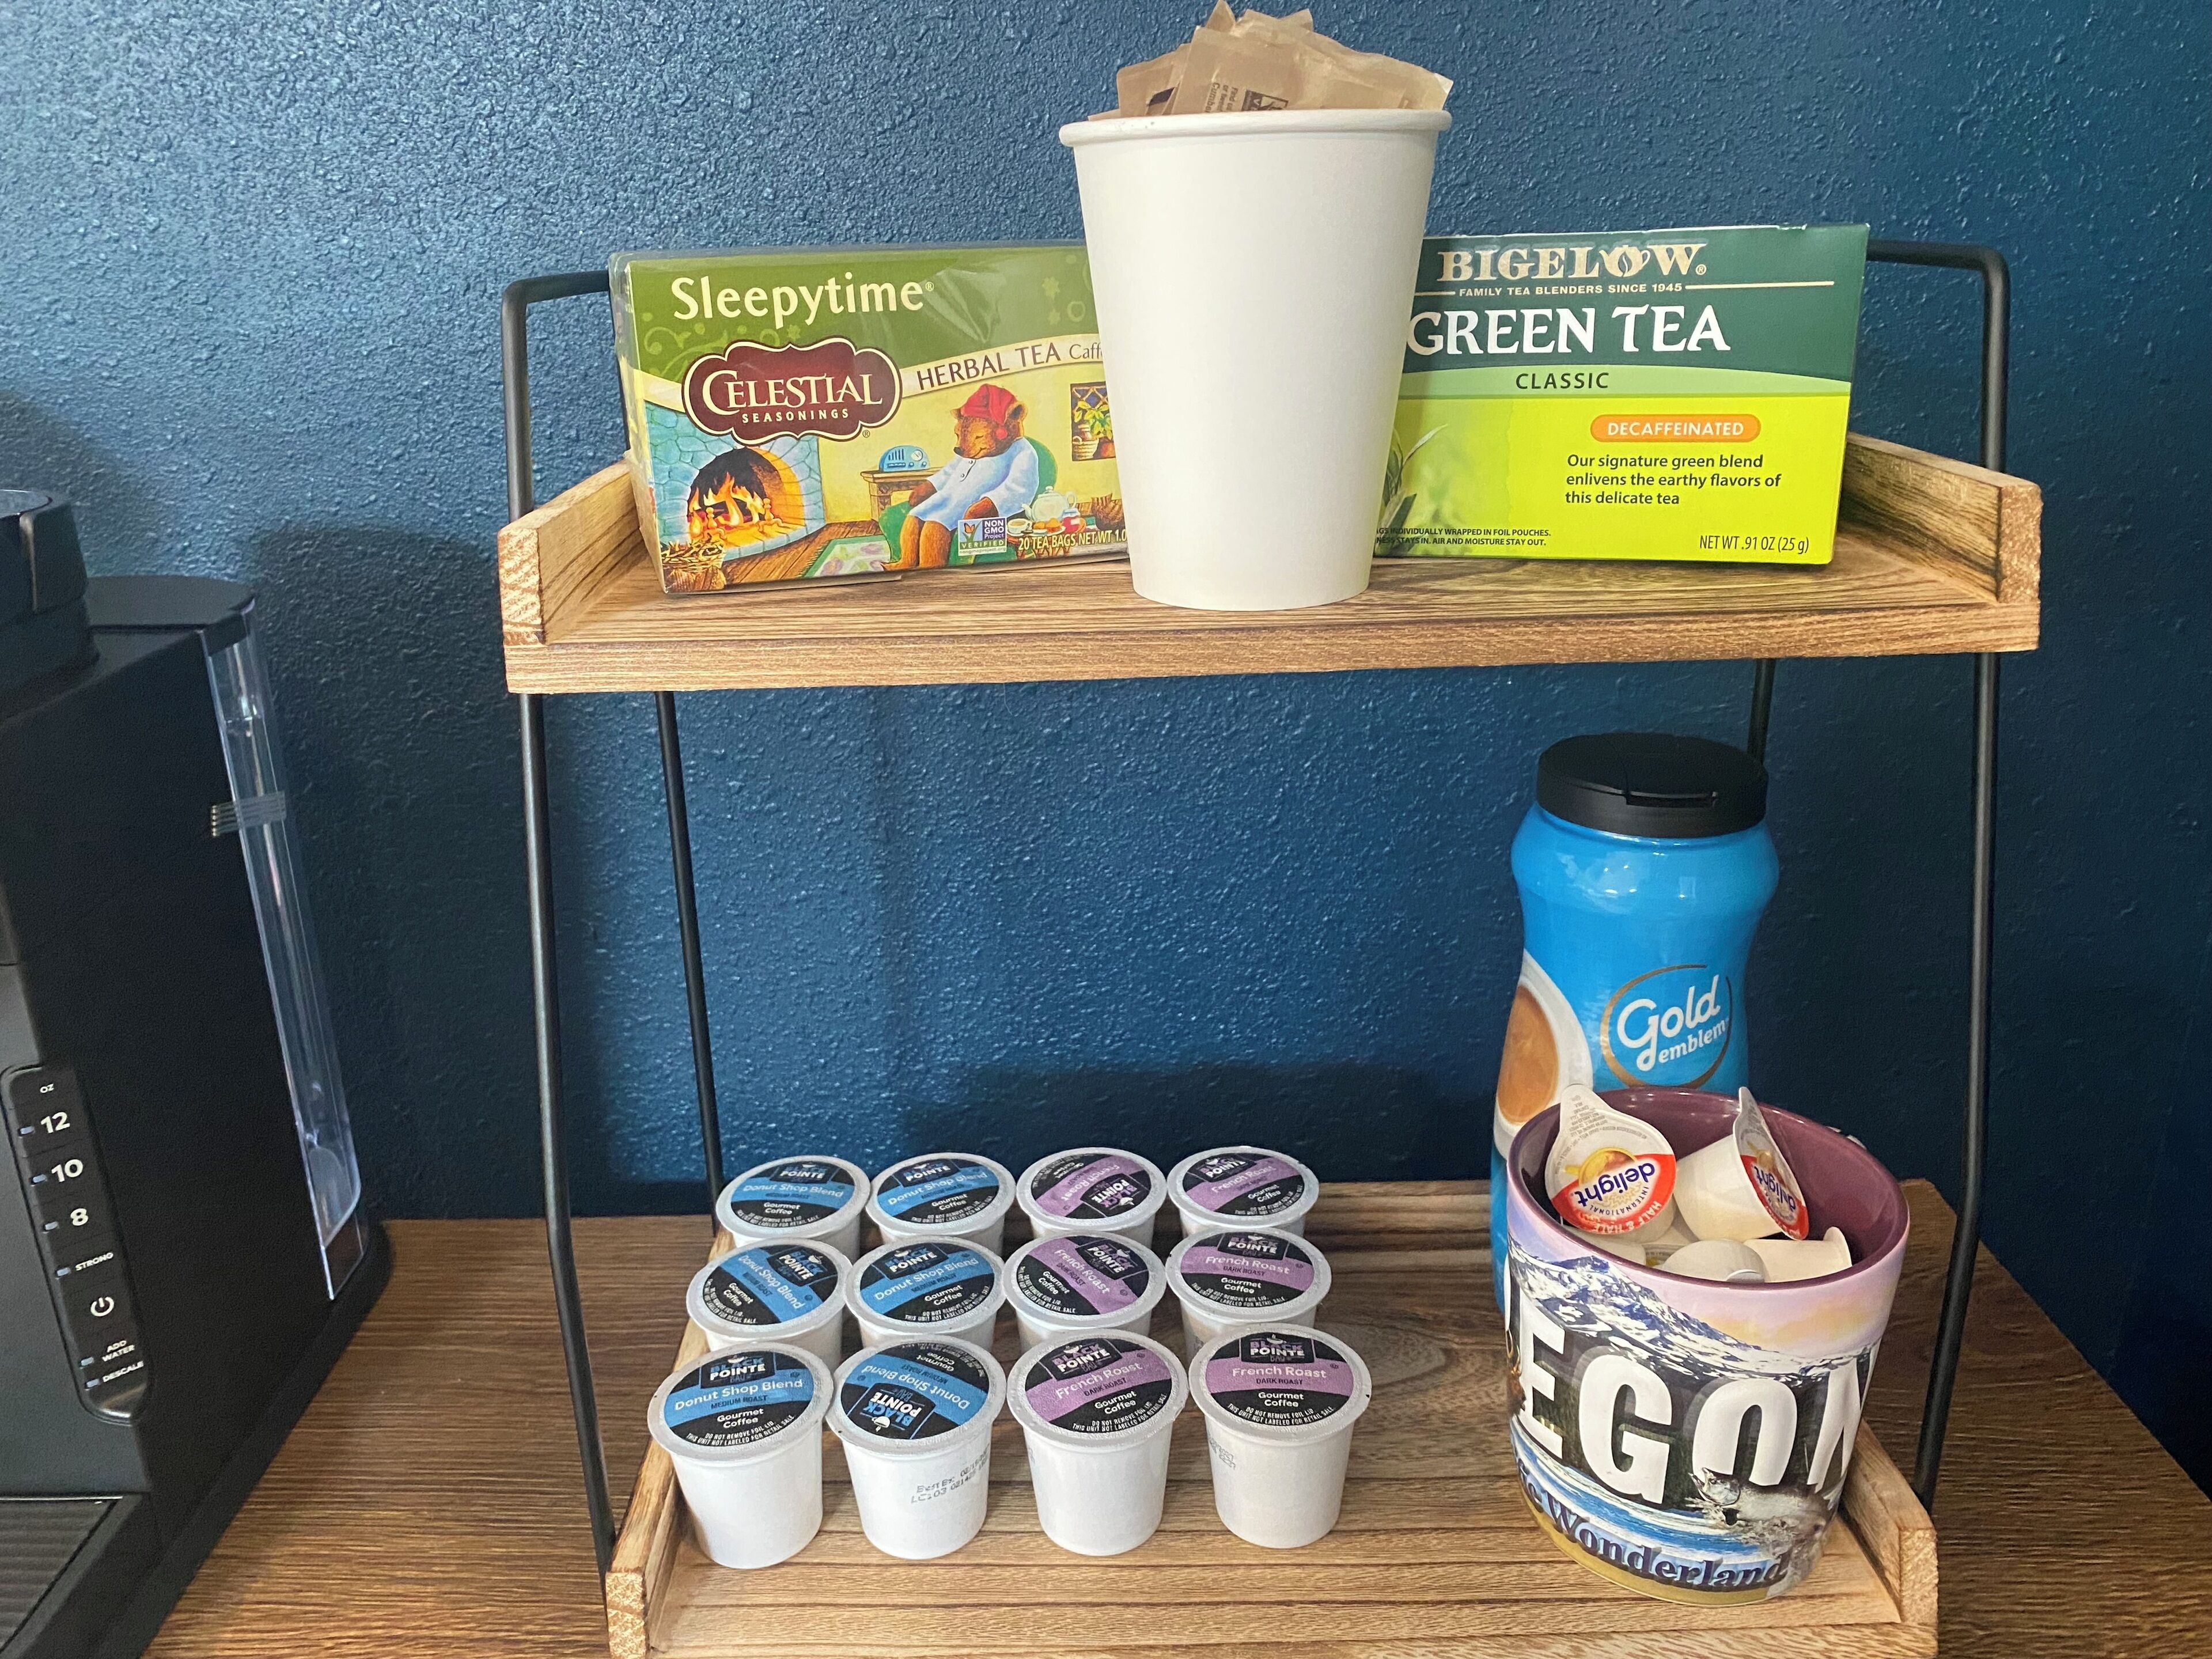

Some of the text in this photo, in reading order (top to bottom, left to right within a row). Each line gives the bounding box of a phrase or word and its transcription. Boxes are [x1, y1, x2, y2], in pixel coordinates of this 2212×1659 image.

[1459, 283, 1682, 297] FAMILY TEA BLENDERS SINCE 1945
[1407, 304, 1731, 355] GREEN TEA
[917, 352, 1009, 390] HERBAL
[1015, 342, 1061, 367] TEA
[1516, 373, 1609, 389] CLASSIC
[702, 370, 882, 415] CELESTIAL
[742, 408, 849, 423] SEASONINGS
[1608, 422, 1744, 436] DECAFFEINATED
[1567, 454, 1763, 470] Our signature green blend
[1566, 473, 1782, 489] enlivens the earthy flavors of
[1566, 491, 1680, 505] this delicate tea
[961, 540, 1004, 548] VERIFIED
[1018, 538, 1030, 550] 20
[1031, 537, 1050, 548] TEA
[1052, 534, 1076, 548] BAGS
[1078, 532, 1095, 544] NET
[1096, 530, 1112, 543] WT
[1699, 535, 1809, 554] NET WT .91 OZ (25 g)
[1617, 974, 1721, 1071] Gold
[1658, 1019, 1727, 1063] emblem
[40, 1112, 70, 1133] 12
[51, 1158, 84, 1183] 10
[743, 1184, 844, 1198] Donut Shop Blend
[888, 1188, 924, 1205] Donut
[924, 1179, 955, 1191] Shop
[1091, 1180, 1130, 1203] POINTE
[1211, 1175, 1248, 1194] French
[1574, 1162, 1655, 1207] delight
[1589, 1187, 1649, 1216] INTERNATIONAL
[70, 1207, 89, 1227] 8
[1638, 1200, 1662, 1226] HALF
[1228, 1241, 1277, 1254] POINTE
[75, 1251, 114, 1271] STRONG
[779, 1254, 814, 1280] POINTE
[889, 1252, 937, 1272] POINTE
[1087, 1247, 1125, 1273] POINTE
[1206, 1256, 1290, 1274] French Roast
[1054, 1249, 1111, 1294] French Roast
[758, 1269, 781, 1287] Shop
[777, 1285, 805, 1309] Blend
[874, 1278, 913, 1300] Donut
[913, 1268, 945, 1282] Shop
[1038, 1277, 1059, 1295] Coffee
[1043, 1271, 1070, 1294] Gourmet
[1221, 1277, 1262, 1289] Gourmet
[1224, 1284, 1255, 1294] Coffee
[723, 1290, 743, 1306] Coffee
[729, 1282, 755, 1305] Gourmet
[924, 1285, 963, 1302] Gourmet
[933, 1291, 963, 1306] Coffee
[102, 1344, 135, 1362] WATER
[107, 1340, 127, 1353] ADD
[1250, 1347, 1305, 1357] POINTE
[916, 1354, 955, 1372] Gourmet
[927, 1351, 955, 1365] Coffee
[1057, 1349, 1110, 1373] POINTE
[103, 1361, 144, 1382] DESCALE
[710, 1363, 766, 1381] POINTE
[1055, 1362, 1143, 1399] French Roast
[1232, 1366, 1327, 1378] French Roast
[861, 1365, 971, 1410] Donut Shop Blend
[1505, 1262, 1880, 1505] EGON
[675, 1378, 803, 1411] Donut Shop Blend
[711, 1397, 741, 1409] MEDIUM
[1094, 1391, 1137, 1410] Gourmet
[1258, 1392, 1304, 1400] Gourmet
[1264, 1399, 1299, 1407] Coffee
[863, 1400, 915, 1426] BLACK
[870, 1392, 922, 1418] POINTE
[1104, 1400, 1137, 1415] Coffee
[717, 1408, 764, 1423] Gourmet
[723, 1417, 758, 1429] Coffee
[1546, 1491, 1786, 1589] Wonderland
